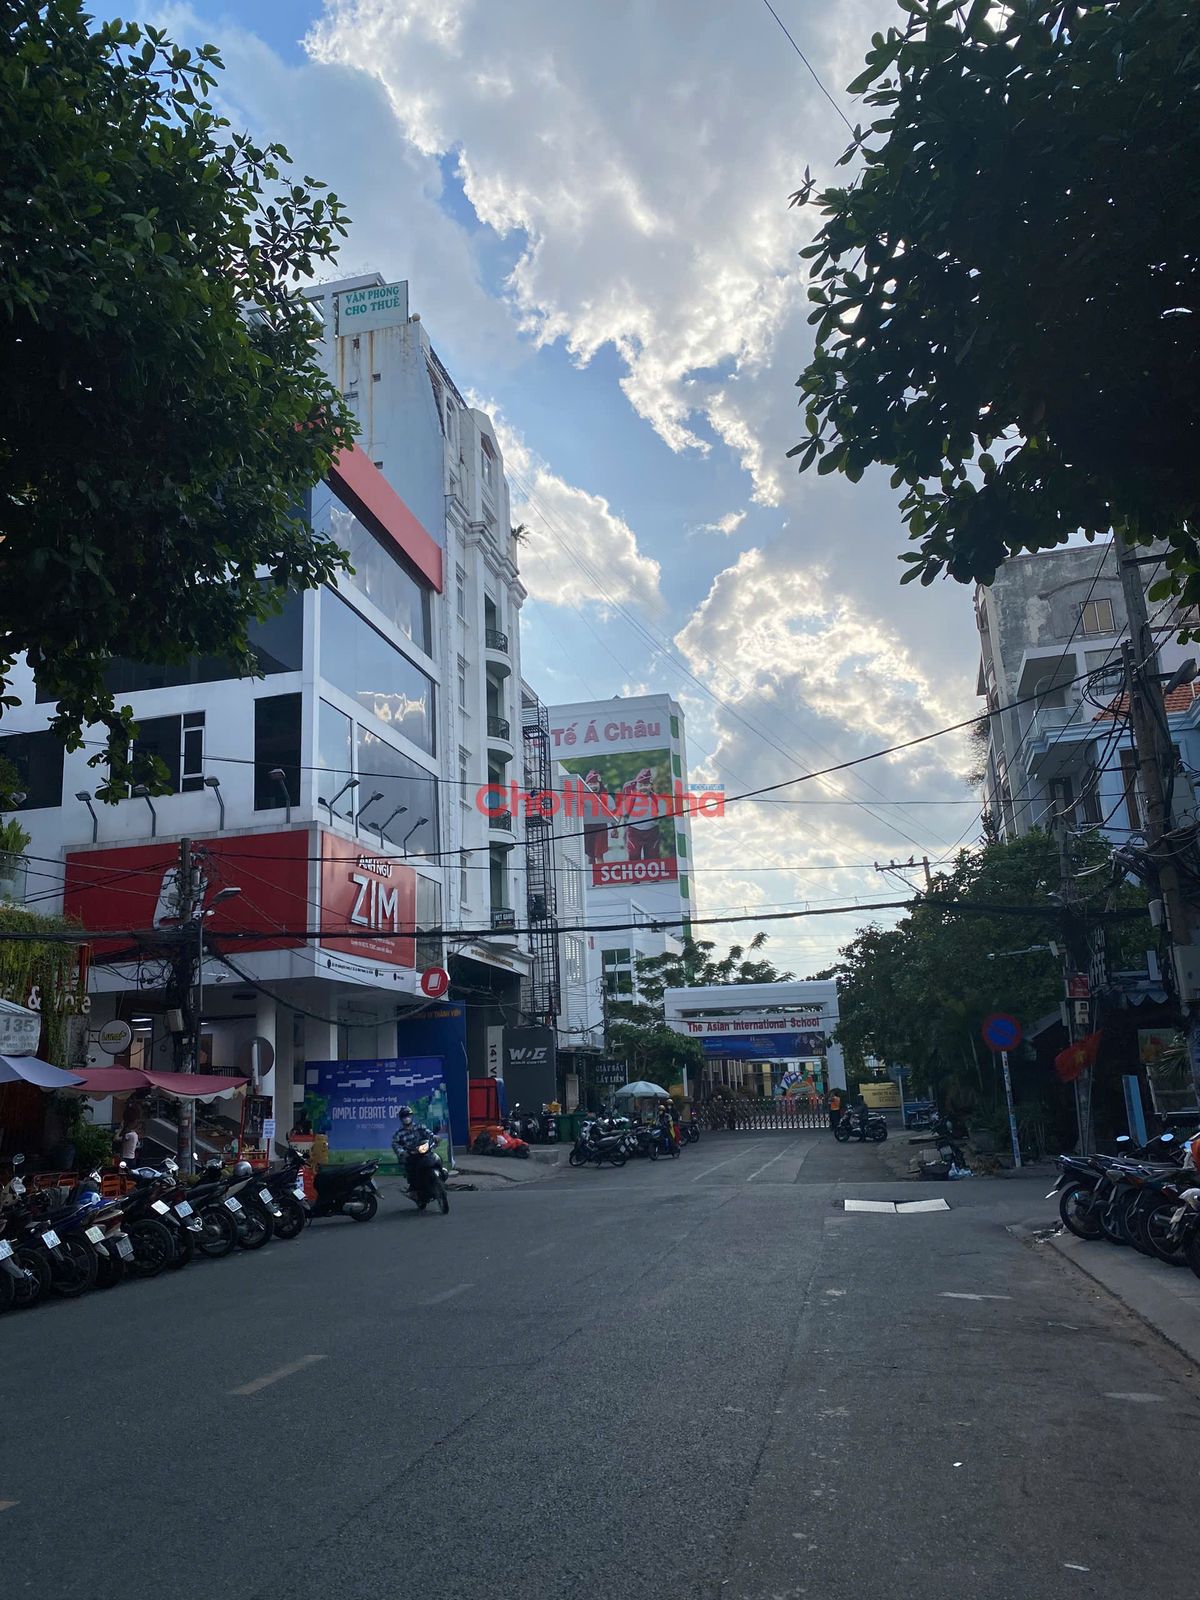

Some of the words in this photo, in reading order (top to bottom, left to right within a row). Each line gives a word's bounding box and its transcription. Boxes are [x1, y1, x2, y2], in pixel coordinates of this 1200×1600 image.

[345, 304, 367, 316] CHO
[370, 296, 400, 311] THUÊ
[551, 722, 579, 746] Tế
[584, 720, 600, 743] Á
[604, 719, 661, 742] Châu
[600, 861, 670, 881] SCHOOL
[350, 872, 398, 932] ZIM
[27, 985, 42, 1010] &
[3, 1017, 35, 1032] 135
[687, 1021, 703, 1033] The
[707, 1021, 730, 1032] Asian
[733, 1019, 787, 1031] International
[790, 1016, 820, 1028] School
[489, 1044, 497, 1062] 141
[332, 1106, 357, 1120] AMPLE
[359, 1106, 386, 1119] DEBATE
